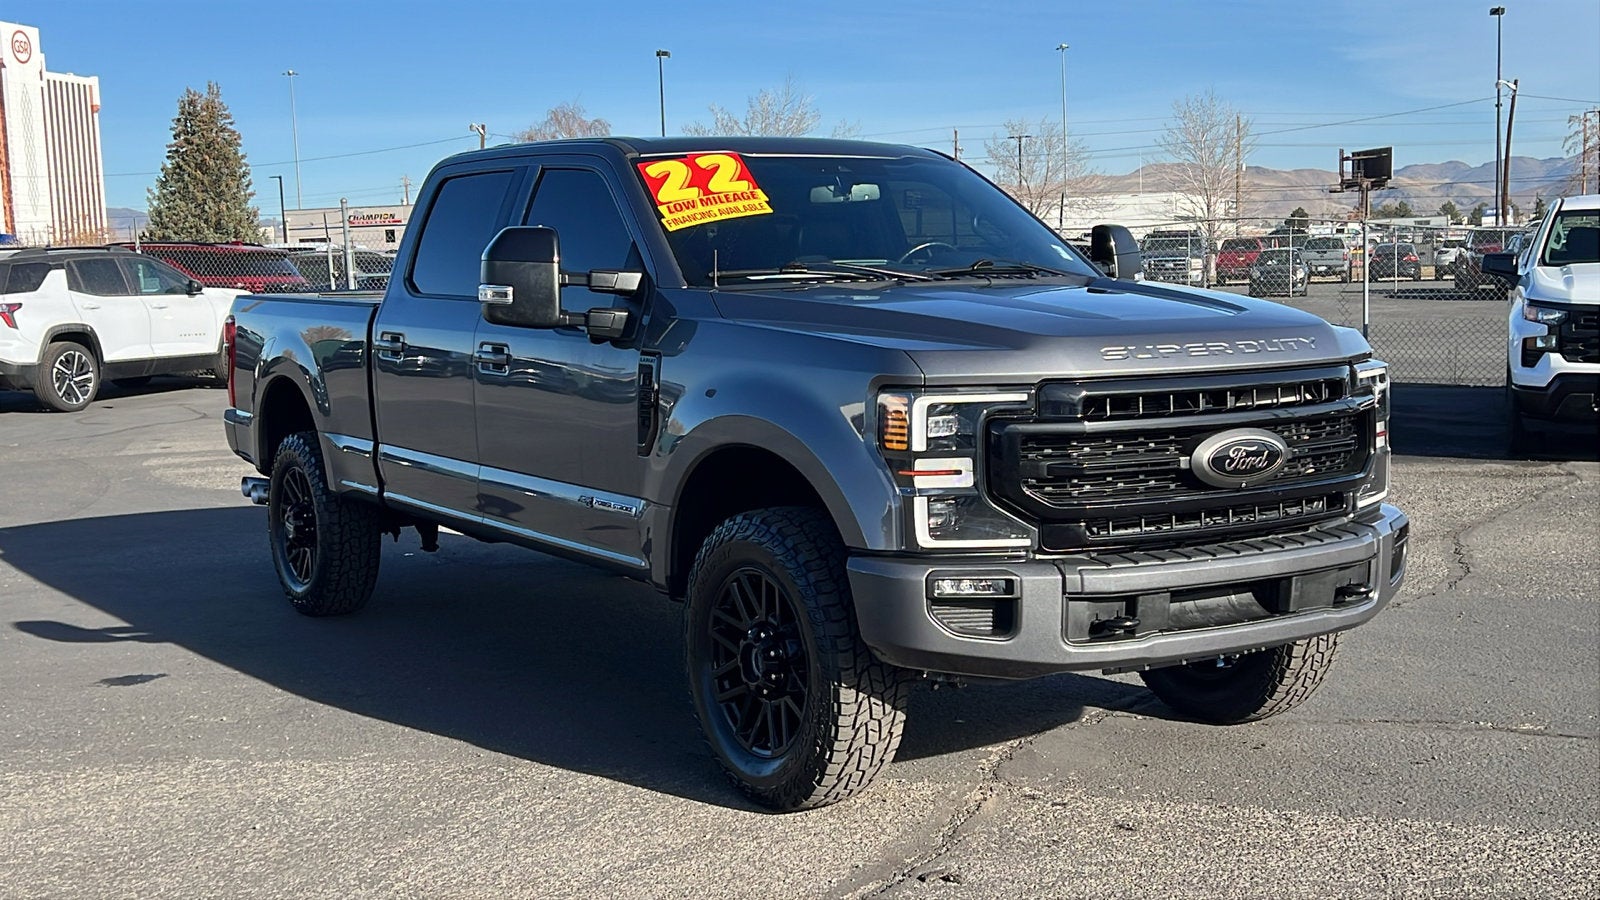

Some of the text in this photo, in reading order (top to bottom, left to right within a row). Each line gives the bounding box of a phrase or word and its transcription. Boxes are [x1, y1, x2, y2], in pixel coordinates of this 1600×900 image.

[645, 154, 753, 203] 22
[665, 202, 768, 228] FINANCING AVAILABLE
[666, 191, 760, 215] LOW MILEAGE
[348, 213, 395, 221] CHAMPION
[1100, 336, 1317, 361] SUPER DUTY
[1225, 445, 1269, 471] Ford
